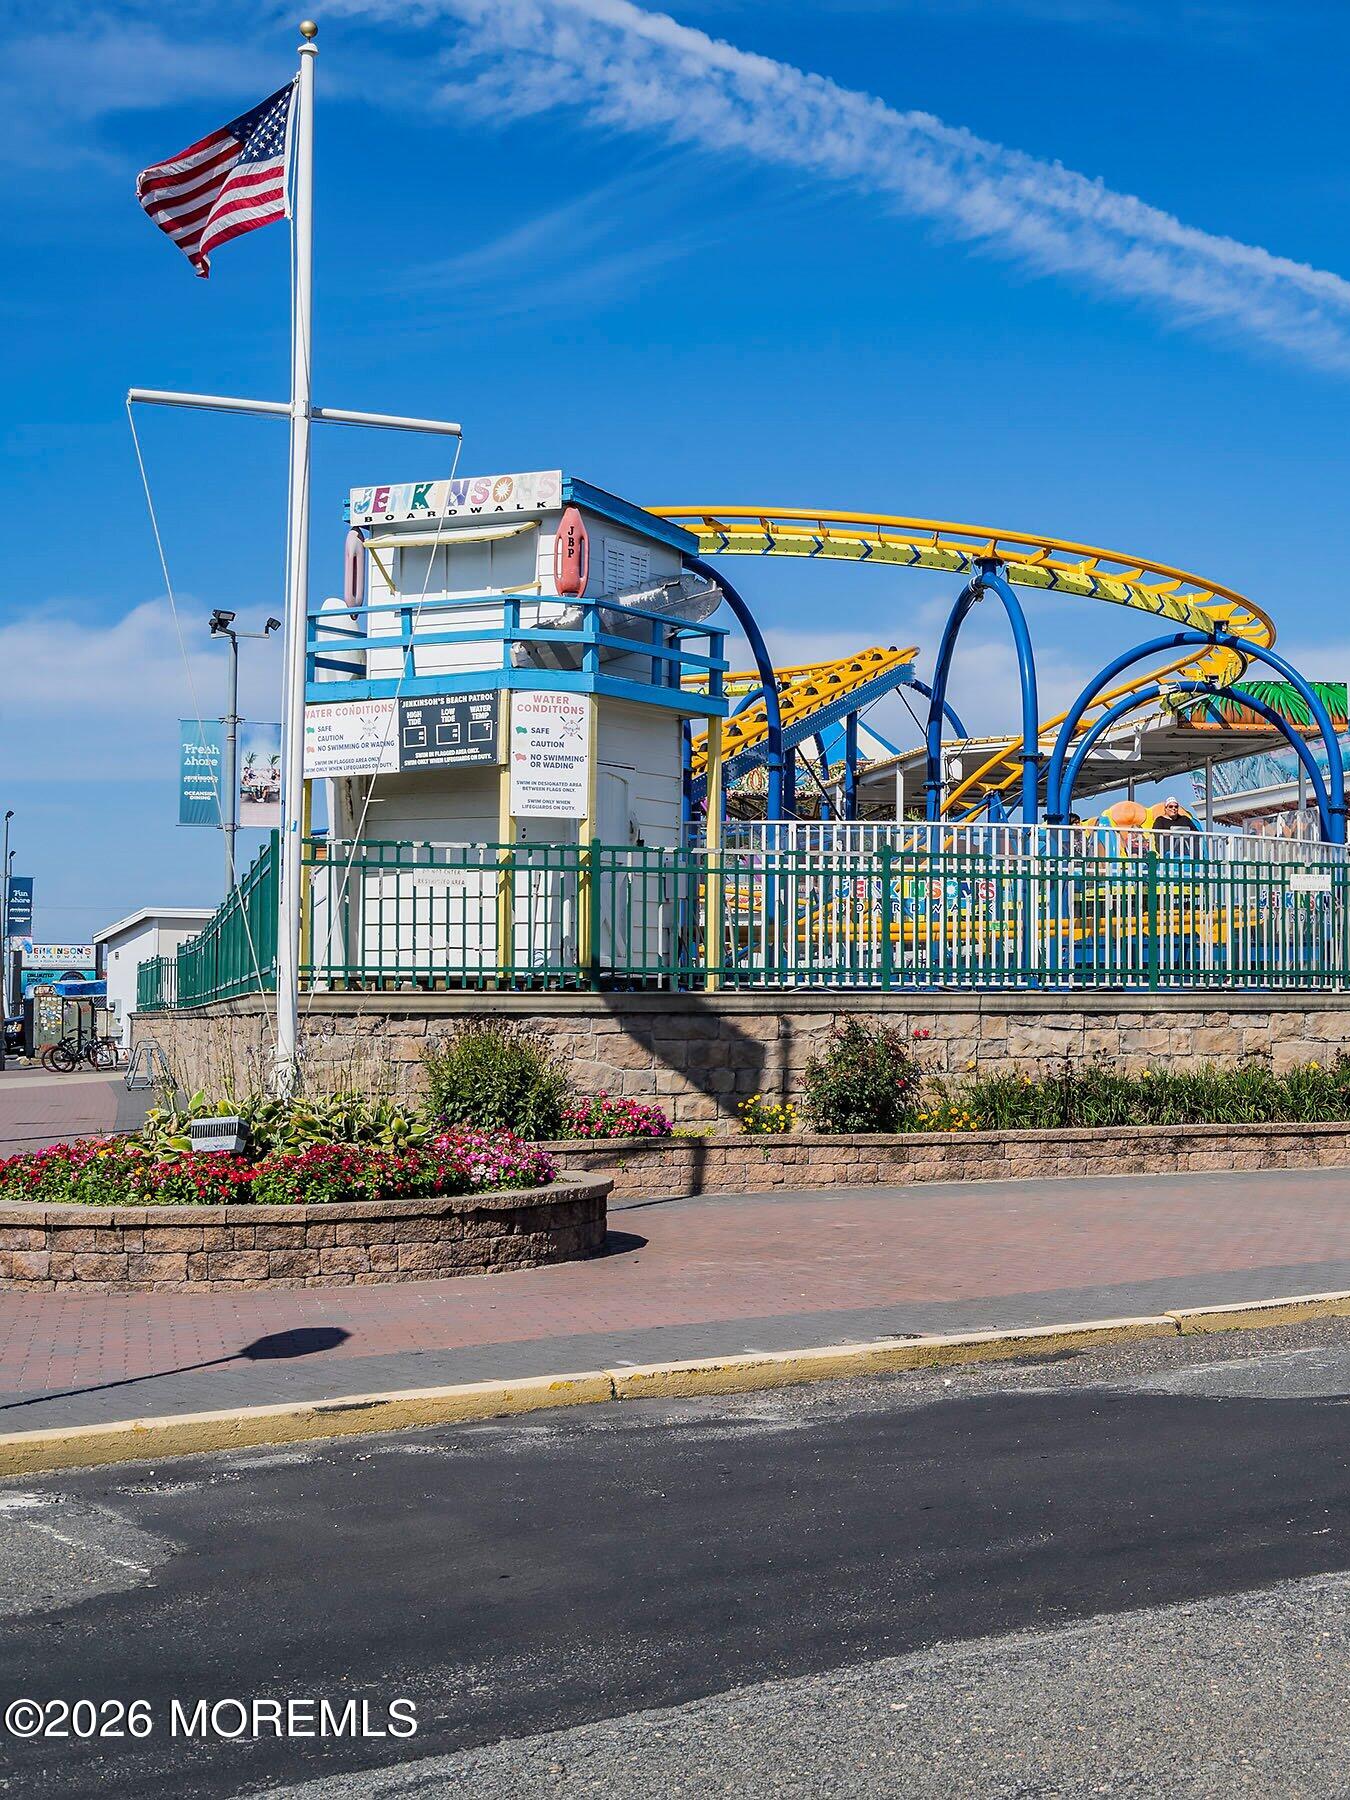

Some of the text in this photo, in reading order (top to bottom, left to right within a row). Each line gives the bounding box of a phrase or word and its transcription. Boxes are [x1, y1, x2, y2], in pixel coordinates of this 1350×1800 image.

[364, 501, 547, 523] BOARDWALK
[446, 694, 468, 704] BEACH
[468, 692, 494, 702] PATROL
[533, 694, 570, 704] WATER
[335, 703, 394, 717] CONDITIONS
[441, 707, 456, 716] LOW
[469, 704, 492, 713] WATER
[517, 704, 585, 715] CONDITIONS
[406, 710, 422, 719] HIGH
[441, 714, 456, 723] TIDE
[471, 712, 490, 720] TEMP
[407, 718, 422, 726] TIDE
[317, 725, 332, 733] SAFE
[317, 734, 344, 743] CAUTION
[327, 742, 360, 751] SWIMMING
[360, 741, 370, 749] OR
[370, 739, 395, 748] WADING
[530, 740, 565, 748] CAUTION
[183, 743, 220, 755] Fresh
[184, 756, 218, 766] shore
[543, 754, 585, 763] SWIMMING
[543, 762, 574, 770] WADING
